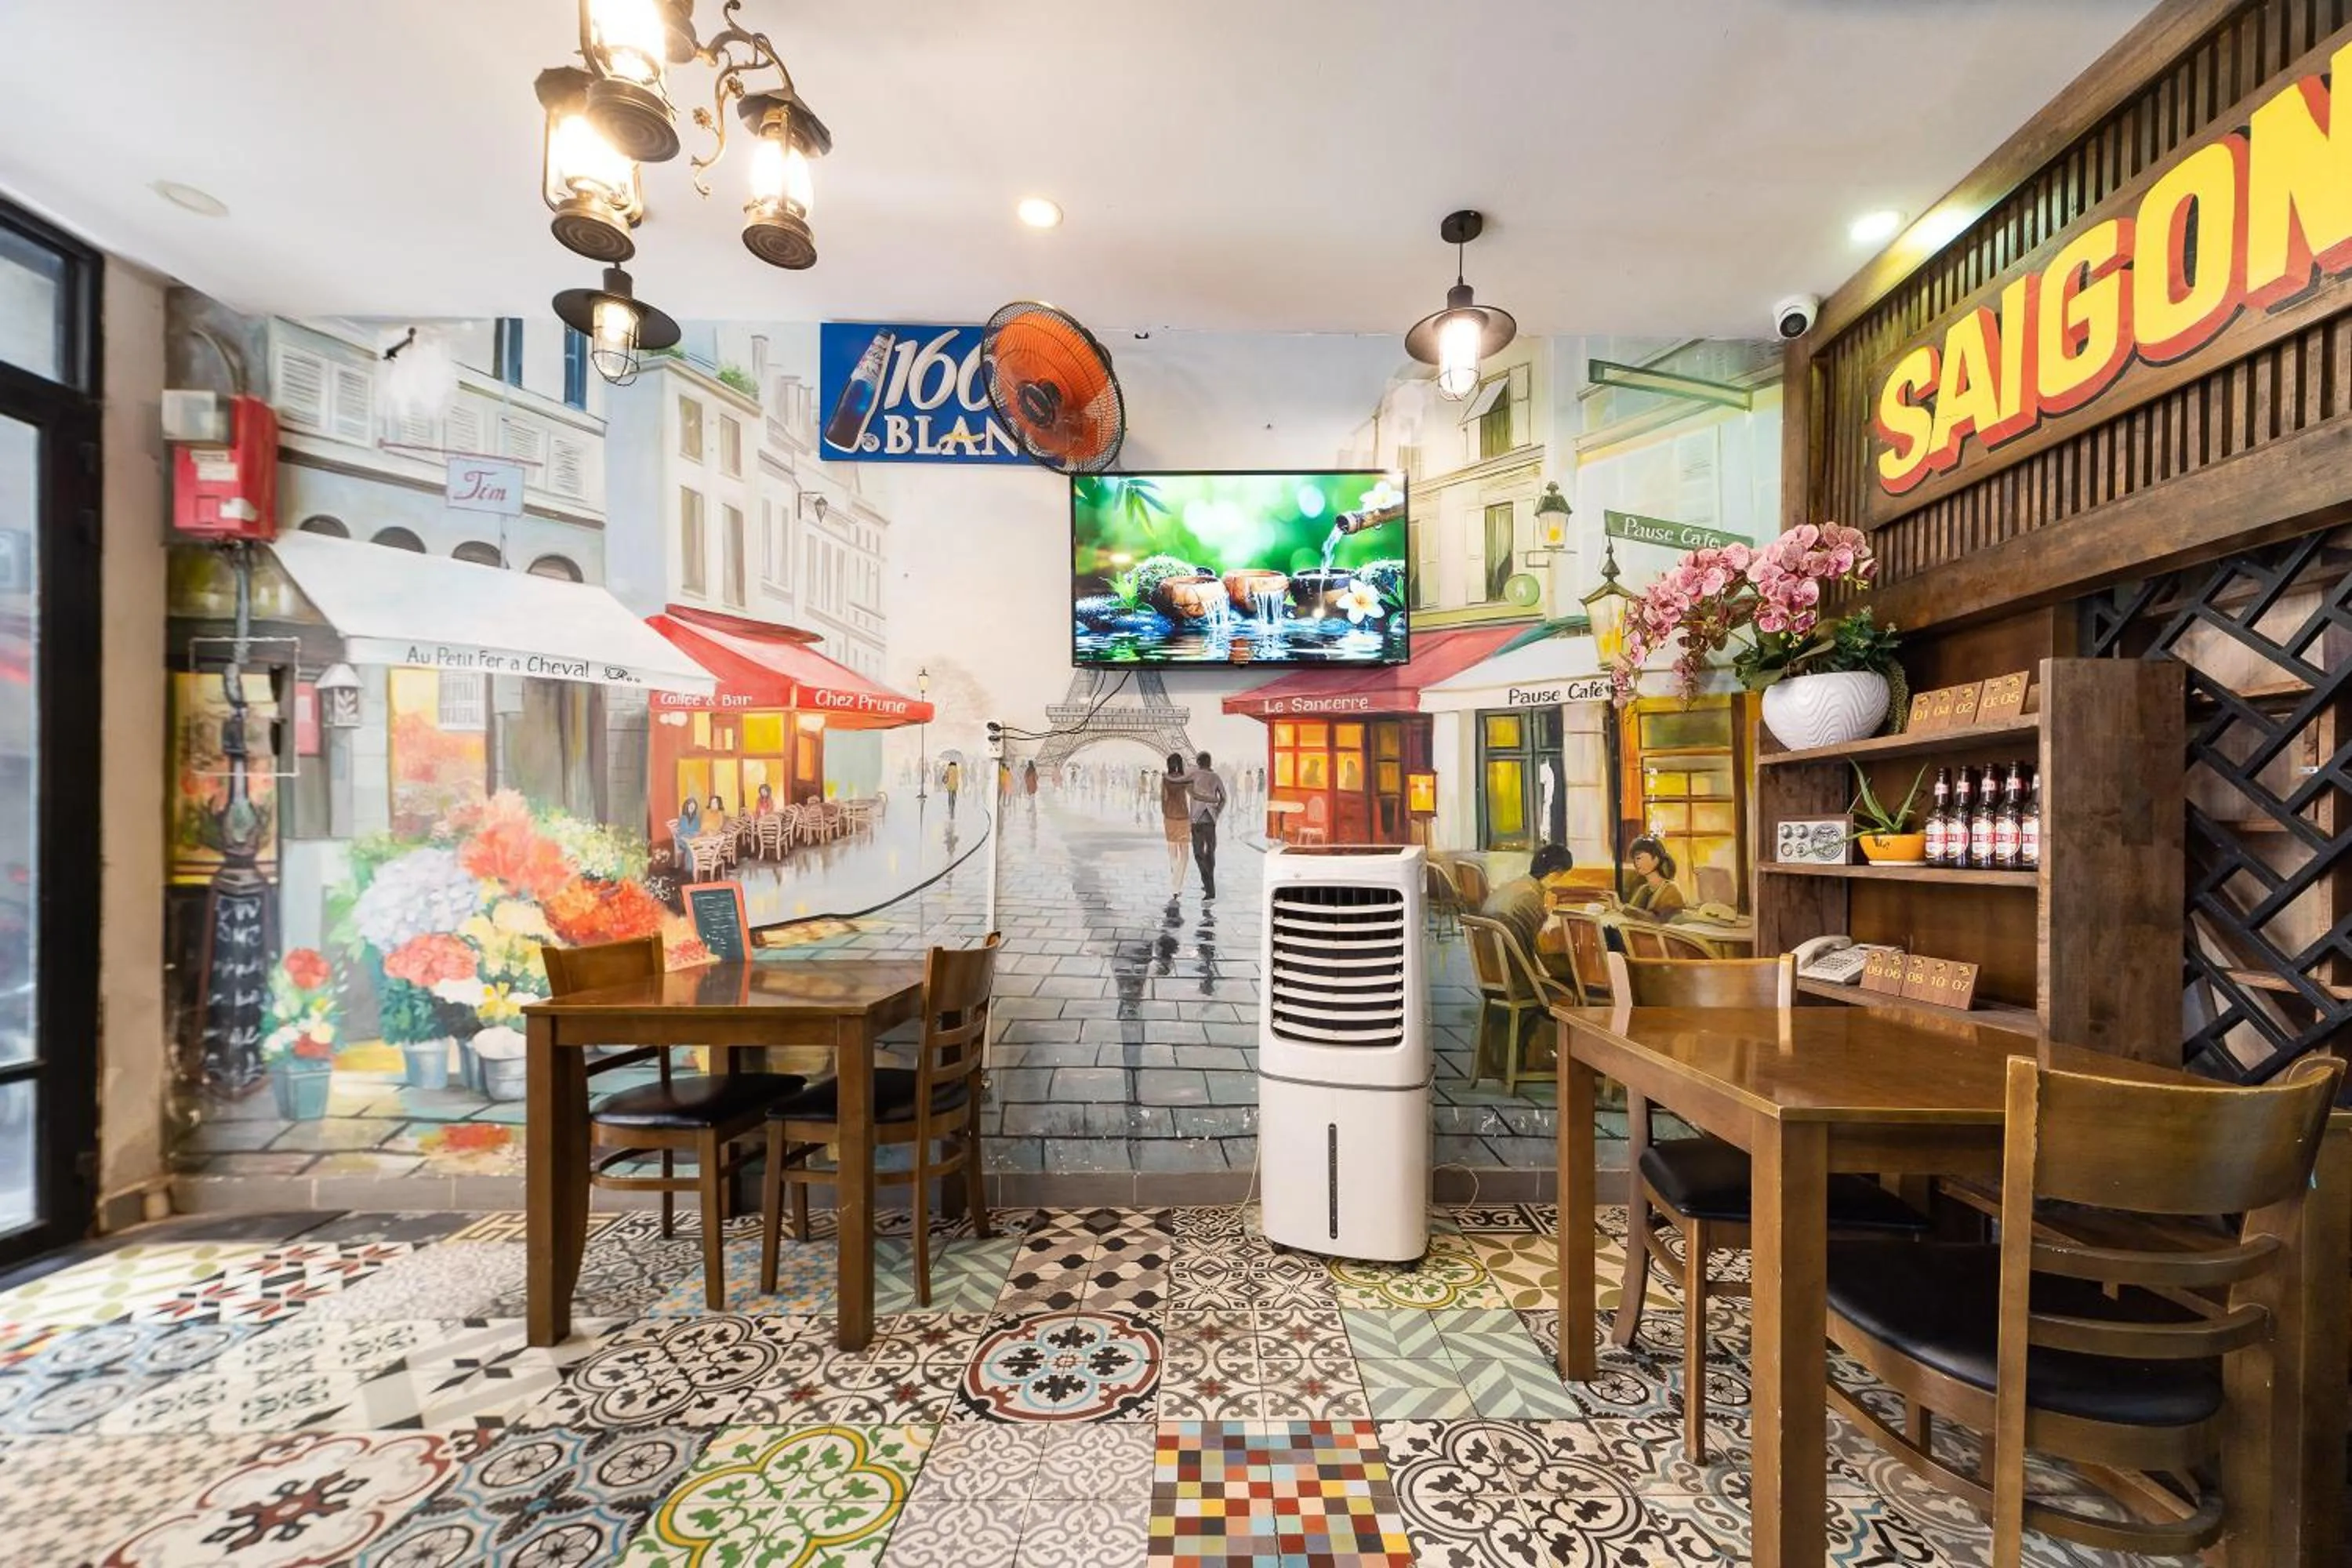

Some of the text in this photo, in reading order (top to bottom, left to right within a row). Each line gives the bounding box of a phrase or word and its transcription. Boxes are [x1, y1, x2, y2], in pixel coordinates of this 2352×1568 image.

[1878, 41, 2352, 497] SAIGON
[884, 328, 1000, 412] 166
[883, 415, 1021, 457] BLAN
[452, 470, 506, 501] Tim
[1623, 517, 1675, 542] Pause
[405, 644, 431, 664] Au
[478, 649, 504, 669] Fer
[526, 655, 590, 678] Cheval
[722, 694, 753, 706] Bar
[815, 689, 906, 714] Chez Prune
[1264, 697, 1369, 713] Le Sancerre
[1508, 688, 1561, 706] Pause
[1914, 709, 1928, 720] 01
[1956, 702, 1973, 714] 02
[2000, 691, 2020, 705] 05
[1884, 968, 1901, 979] 06
[1931, 975, 1946, 988] 10
[1951, 979, 1970, 992] 07
